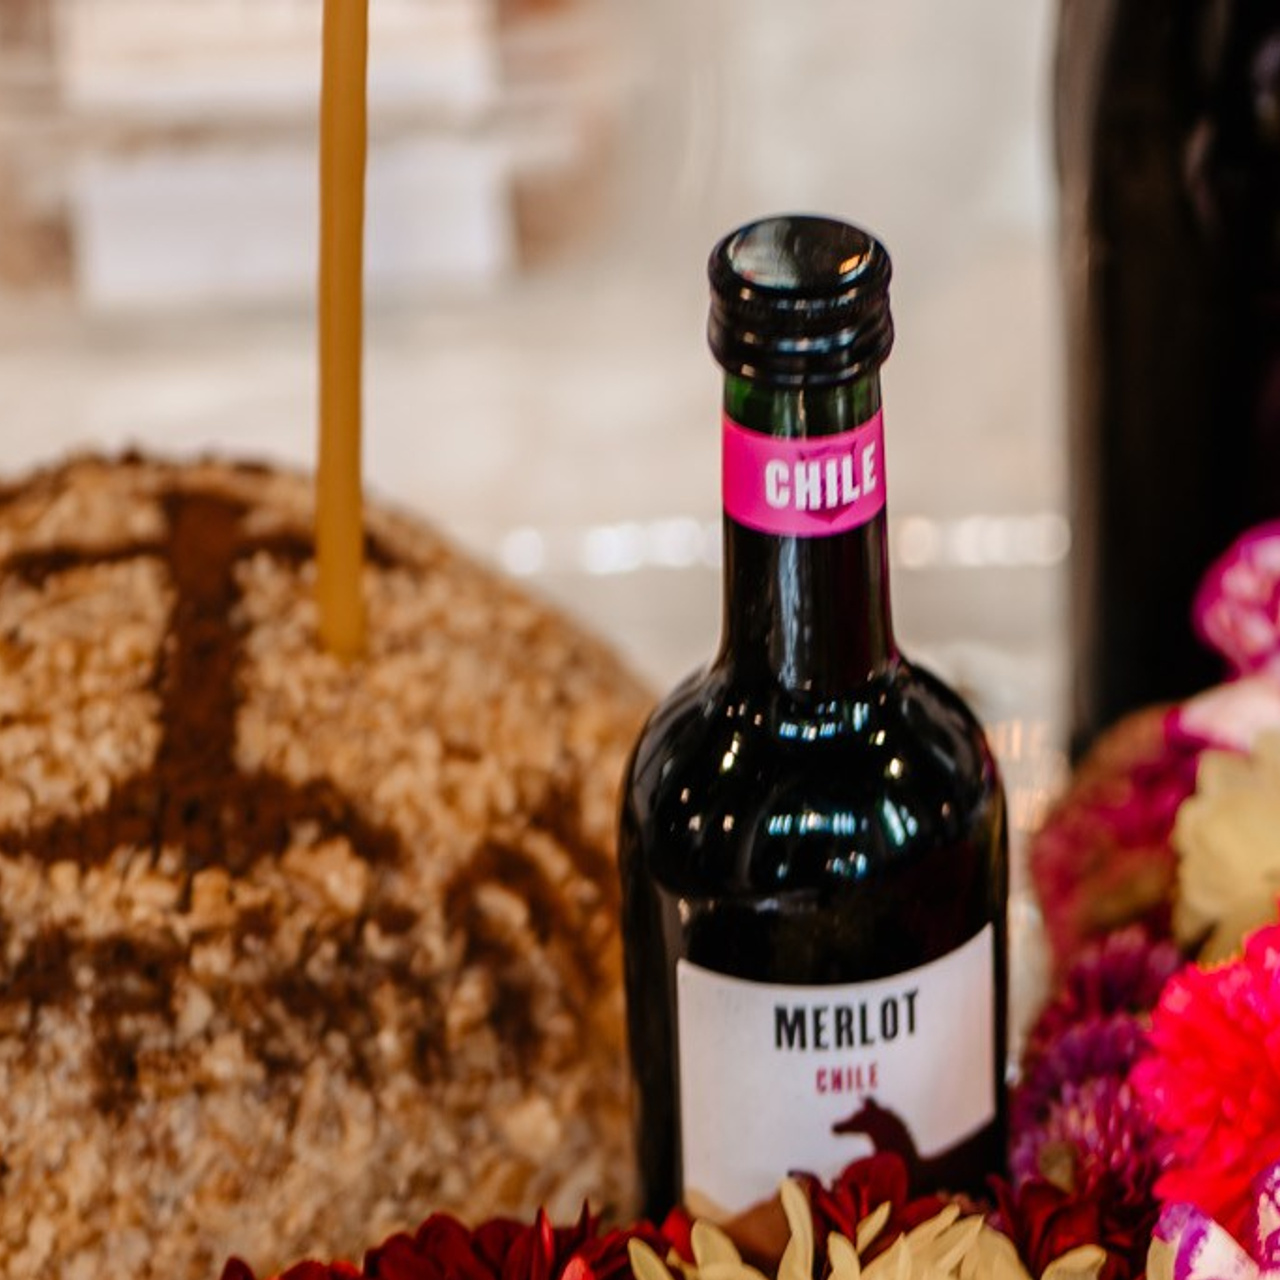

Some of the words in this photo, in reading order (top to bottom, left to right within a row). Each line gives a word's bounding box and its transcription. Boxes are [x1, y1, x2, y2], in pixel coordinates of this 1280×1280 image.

[765, 442, 877, 511] CHILE
[774, 988, 919, 1051] MERLOT
[815, 1063, 879, 1094] CHILE
